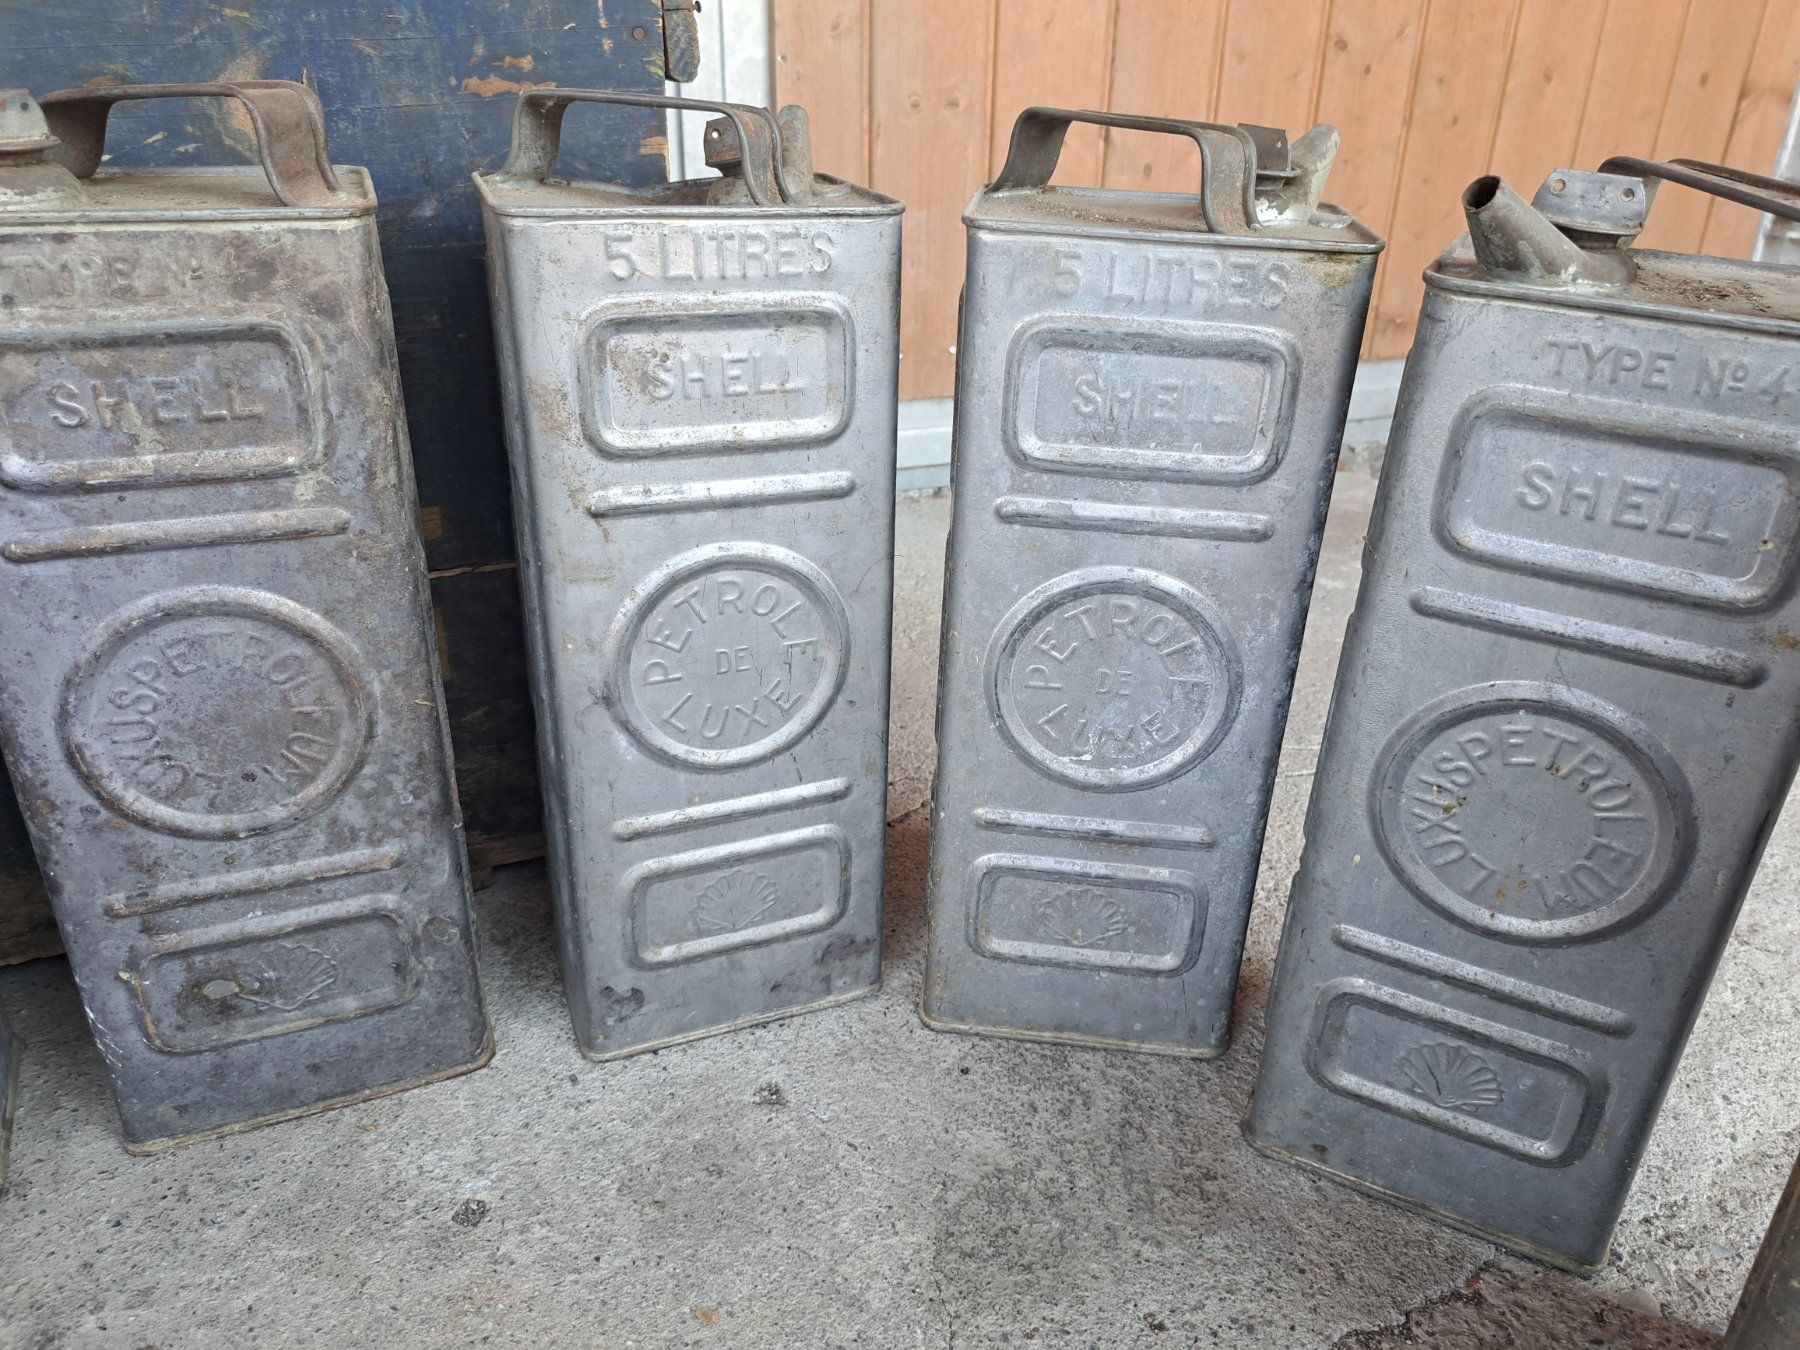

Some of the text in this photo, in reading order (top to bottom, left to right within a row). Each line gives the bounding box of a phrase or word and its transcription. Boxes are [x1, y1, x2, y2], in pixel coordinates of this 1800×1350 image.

[601, 228, 836, 282] 5 LITRES
[1050, 249, 1292, 310] 5 LITRES
[647, 350, 806, 401] SHELL
[1546, 336, 1678, 391] TYPE
[47, 376, 267, 430] SHELL
[1071, 372, 1242, 428] SHELL
[1513, 459, 1731, 547] SHELL
[641, 576, 819, 687] PETROLE
[714, 644, 752, 676] DE
[1096, 667, 1134, 697] DE
[661, 677, 804, 743] LUXE
[1036, 703, 1181, 762] LUXE
